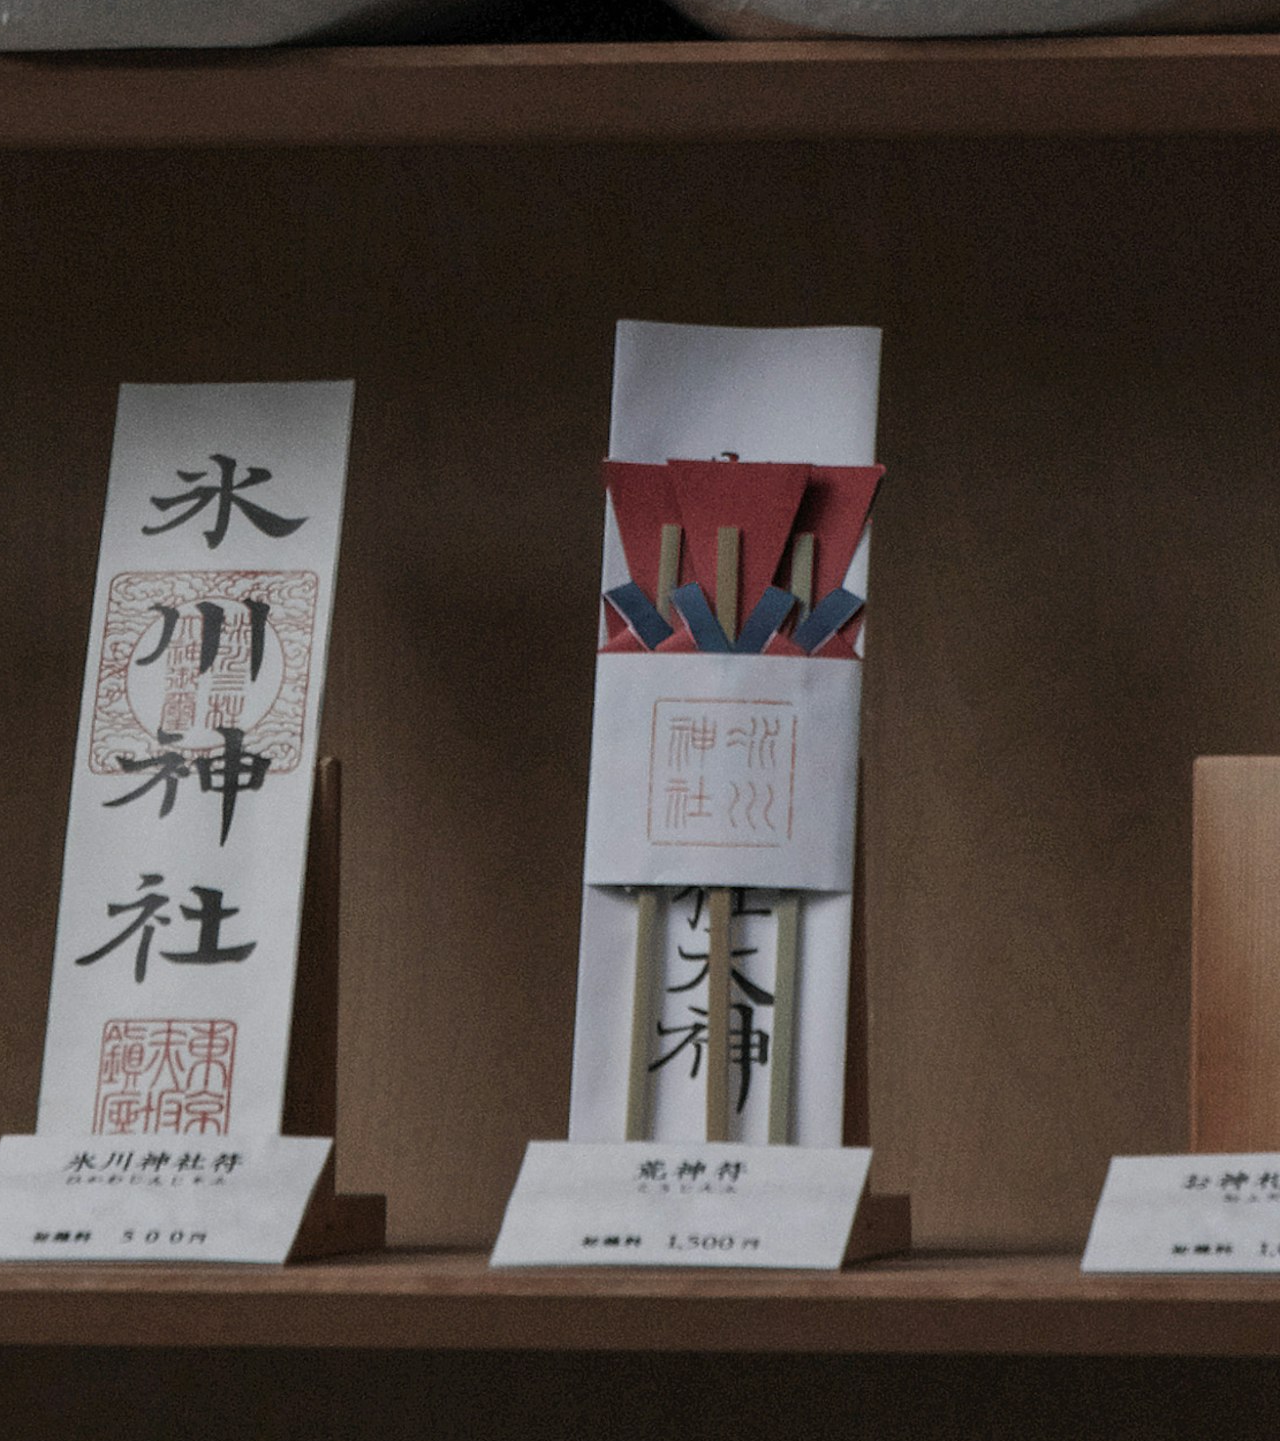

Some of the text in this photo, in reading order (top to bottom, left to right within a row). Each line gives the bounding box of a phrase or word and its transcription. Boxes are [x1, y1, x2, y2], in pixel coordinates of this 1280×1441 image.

[74, 453, 308, 984] 氷川神社
[70, 1151, 242, 1173] 氷川神社符
